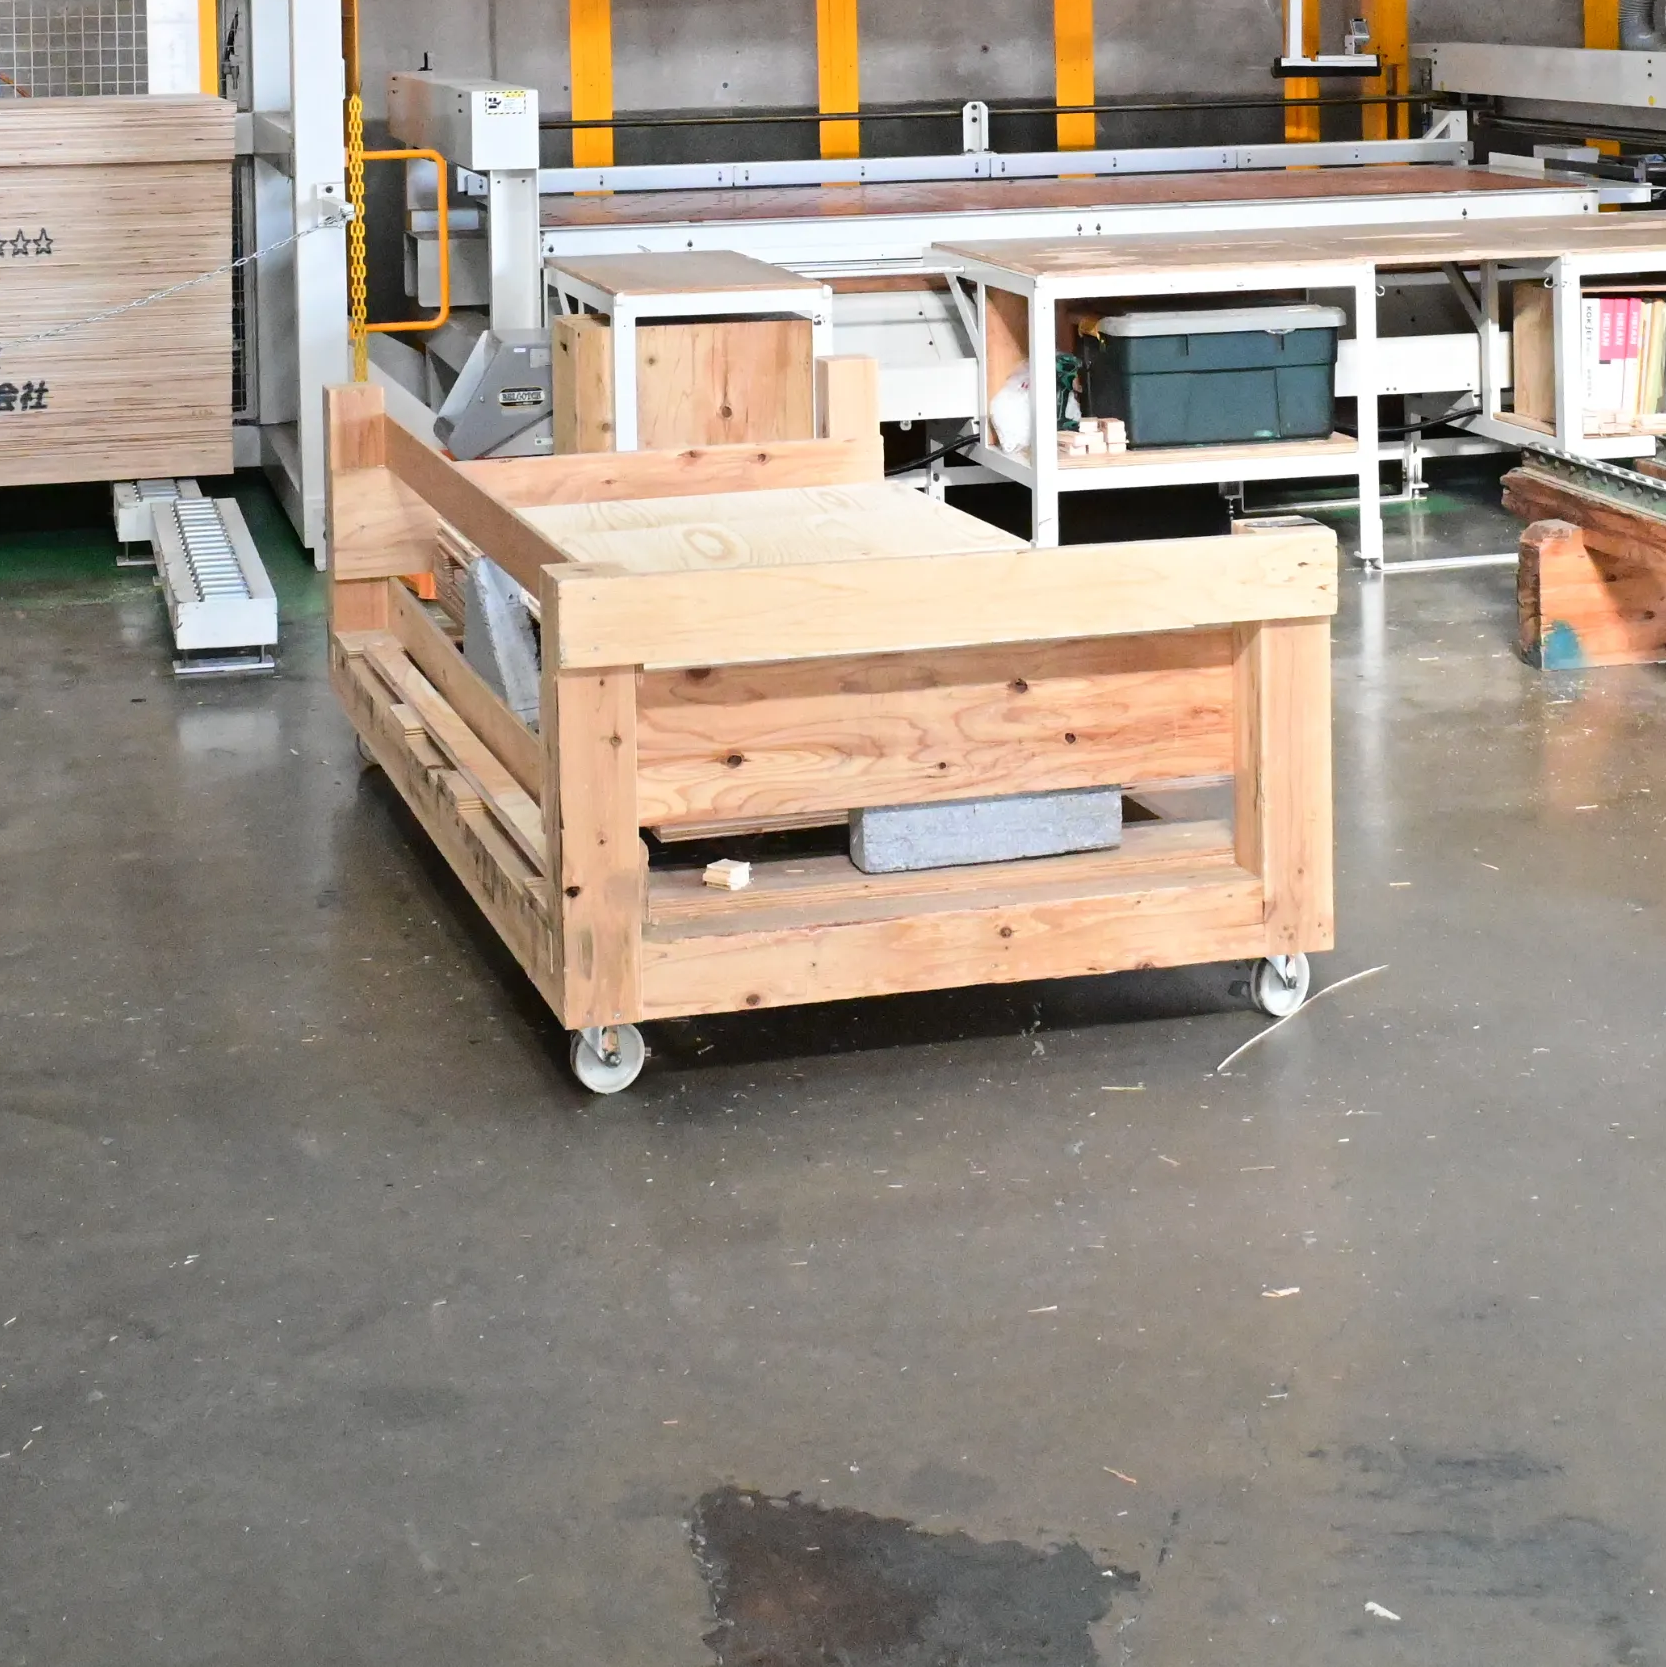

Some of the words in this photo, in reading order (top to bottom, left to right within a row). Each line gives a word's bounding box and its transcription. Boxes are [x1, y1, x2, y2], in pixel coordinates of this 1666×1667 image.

[1601, 311, 1612, 347] HEIAN
[1615, 311, 1626, 346] HEIAN
[1629, 310, 1639, 345] HEIAN
